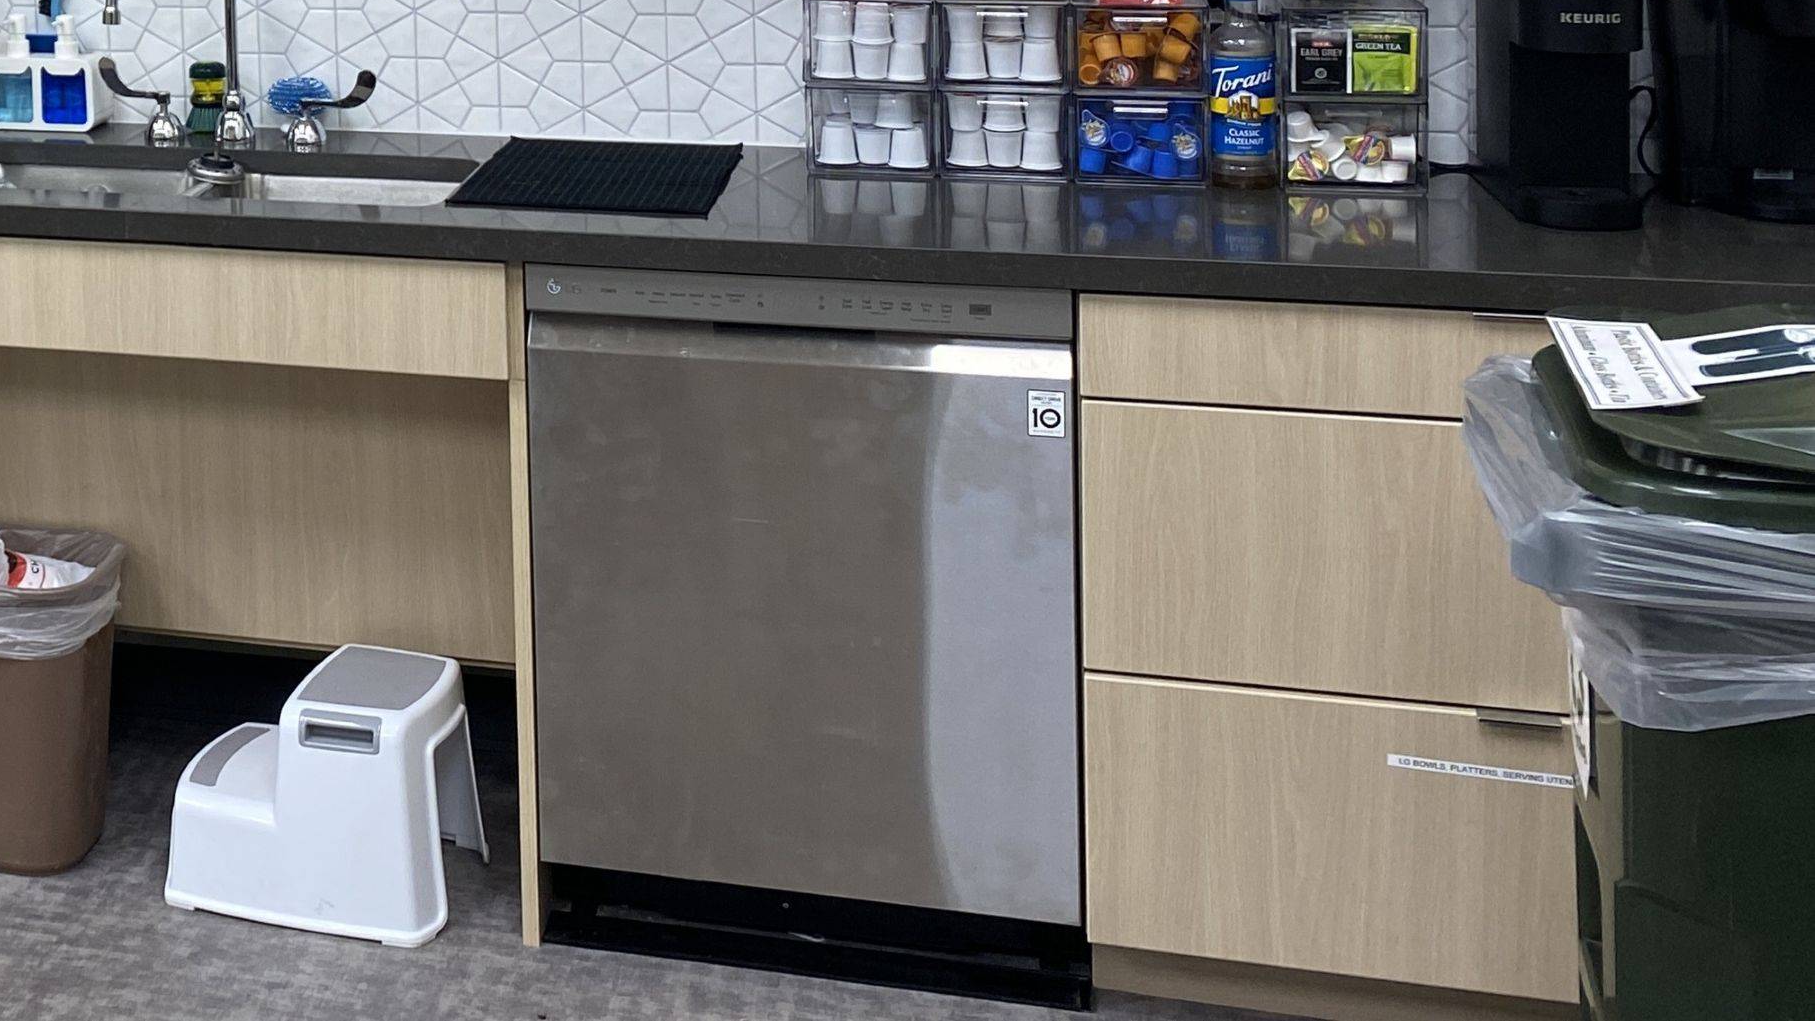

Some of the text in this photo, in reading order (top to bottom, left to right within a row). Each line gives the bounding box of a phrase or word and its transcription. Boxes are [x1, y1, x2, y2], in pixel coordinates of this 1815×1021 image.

[1560, 12, 1621, 24] KEURIG
[1300, 48, 1320, 57] EARL
[1355, 42, 1402, 51] GREEN TEA
[1211, 63, 1273, 98] Torani
[1229, 128, 1260, 137] CLASSIC
[1224, 136, 1264, 145] HAZELNUT
[1588, 356, 1608, 371] Glass
[1597, 373, 1621, 389] Bottles
[1609, 393, 1630, 403] Tin
[1032, 408, 1061, 429] 10
[1398, 758, 1411, 766] LG
[1502, 771, 1544, 783] SERVING
[1546, 776, 1573, 787] UTEN
